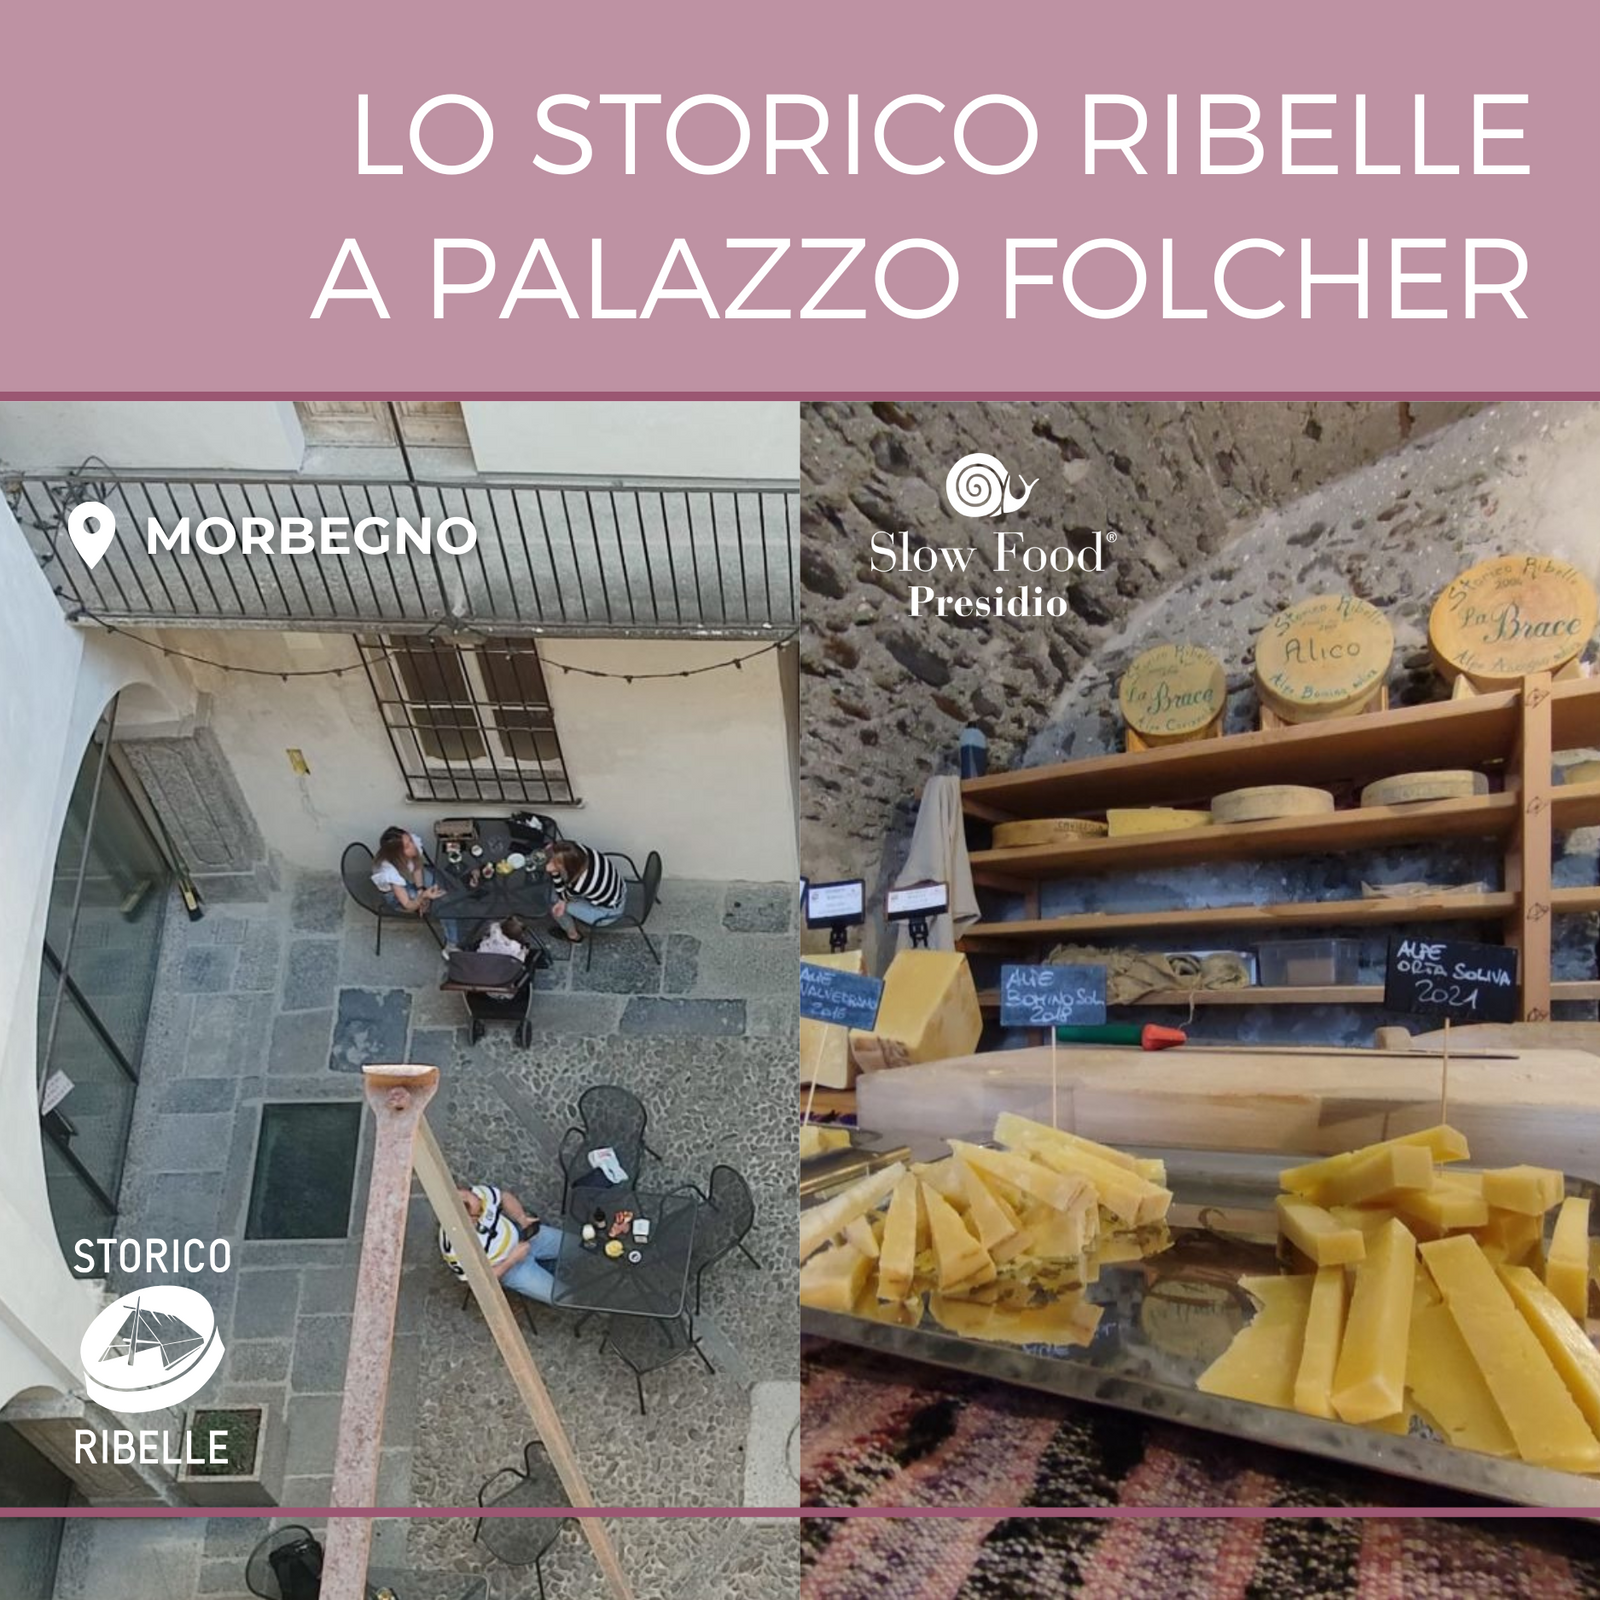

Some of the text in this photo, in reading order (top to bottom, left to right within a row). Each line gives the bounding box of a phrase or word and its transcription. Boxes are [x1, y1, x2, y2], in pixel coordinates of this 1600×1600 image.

[1461, 599, 1581, 644] La Brace
[1284, 638, 1360, 663] Alico
[1147, 681, 1214, 715] Brace
[1397, 940, 1447, 960] ALPE
[1397, 961, 1511, 987] ORTA SOLIVA
[1415, 979, 1479, 1010] 2021
